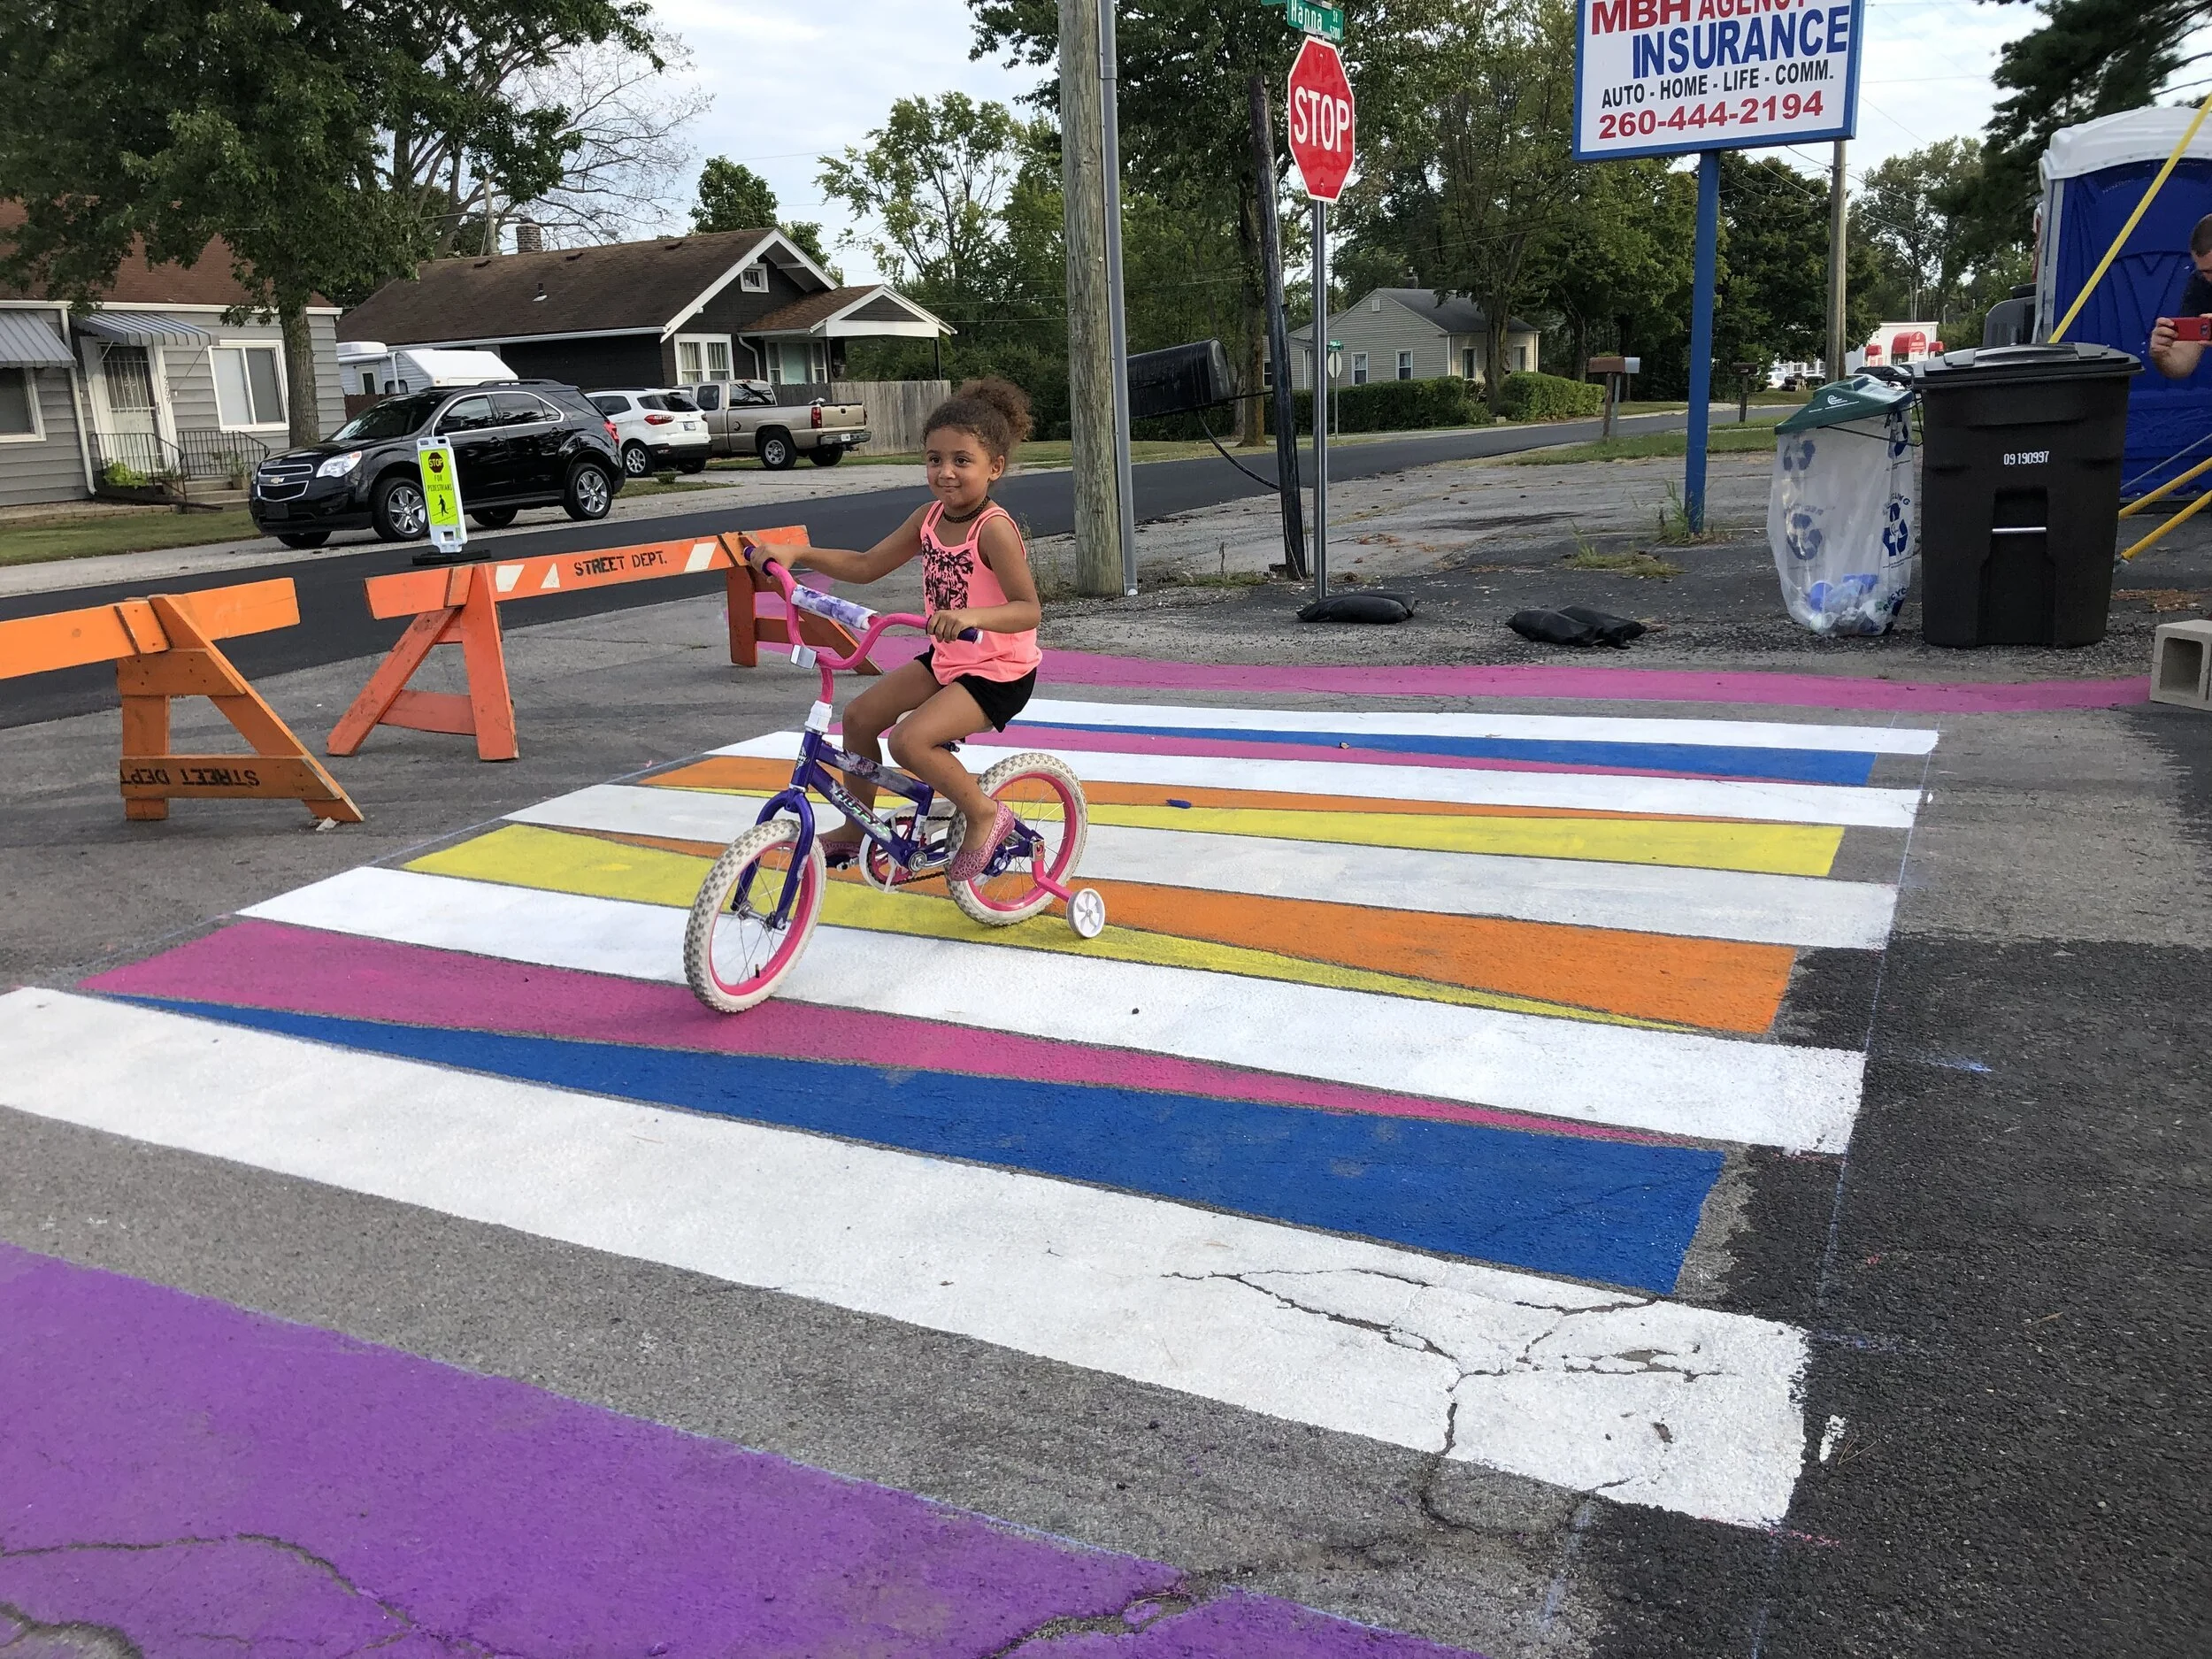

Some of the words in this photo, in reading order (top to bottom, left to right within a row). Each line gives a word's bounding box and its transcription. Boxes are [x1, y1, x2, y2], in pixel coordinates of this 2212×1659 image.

[1291, 0, 1323, 31] Hanna
[1333, 11, 1339, 23] St
[1592, 0, 1690, 35] MBH
[1698, 0, 1805, 20] AGEN
[1632, 5, 1850, 80] INSURANCE
[1601, 83, 1645, 109] AUTO
[1660, 74, 1708, 100] HOME
[1724, 67, 1759, 92] LIFE
[1775, 59, 1834, 85] COMM.
[1294, 86, 1350, 153] STOP
[1599, 90, 1824, 139] 260-444-2194
[428, 458, 443, 467] STOP
[574, 556, 625, 576] STREET
[632, 550, 667, 569] DEPT.
[180, 768, 260, 787] STREET
